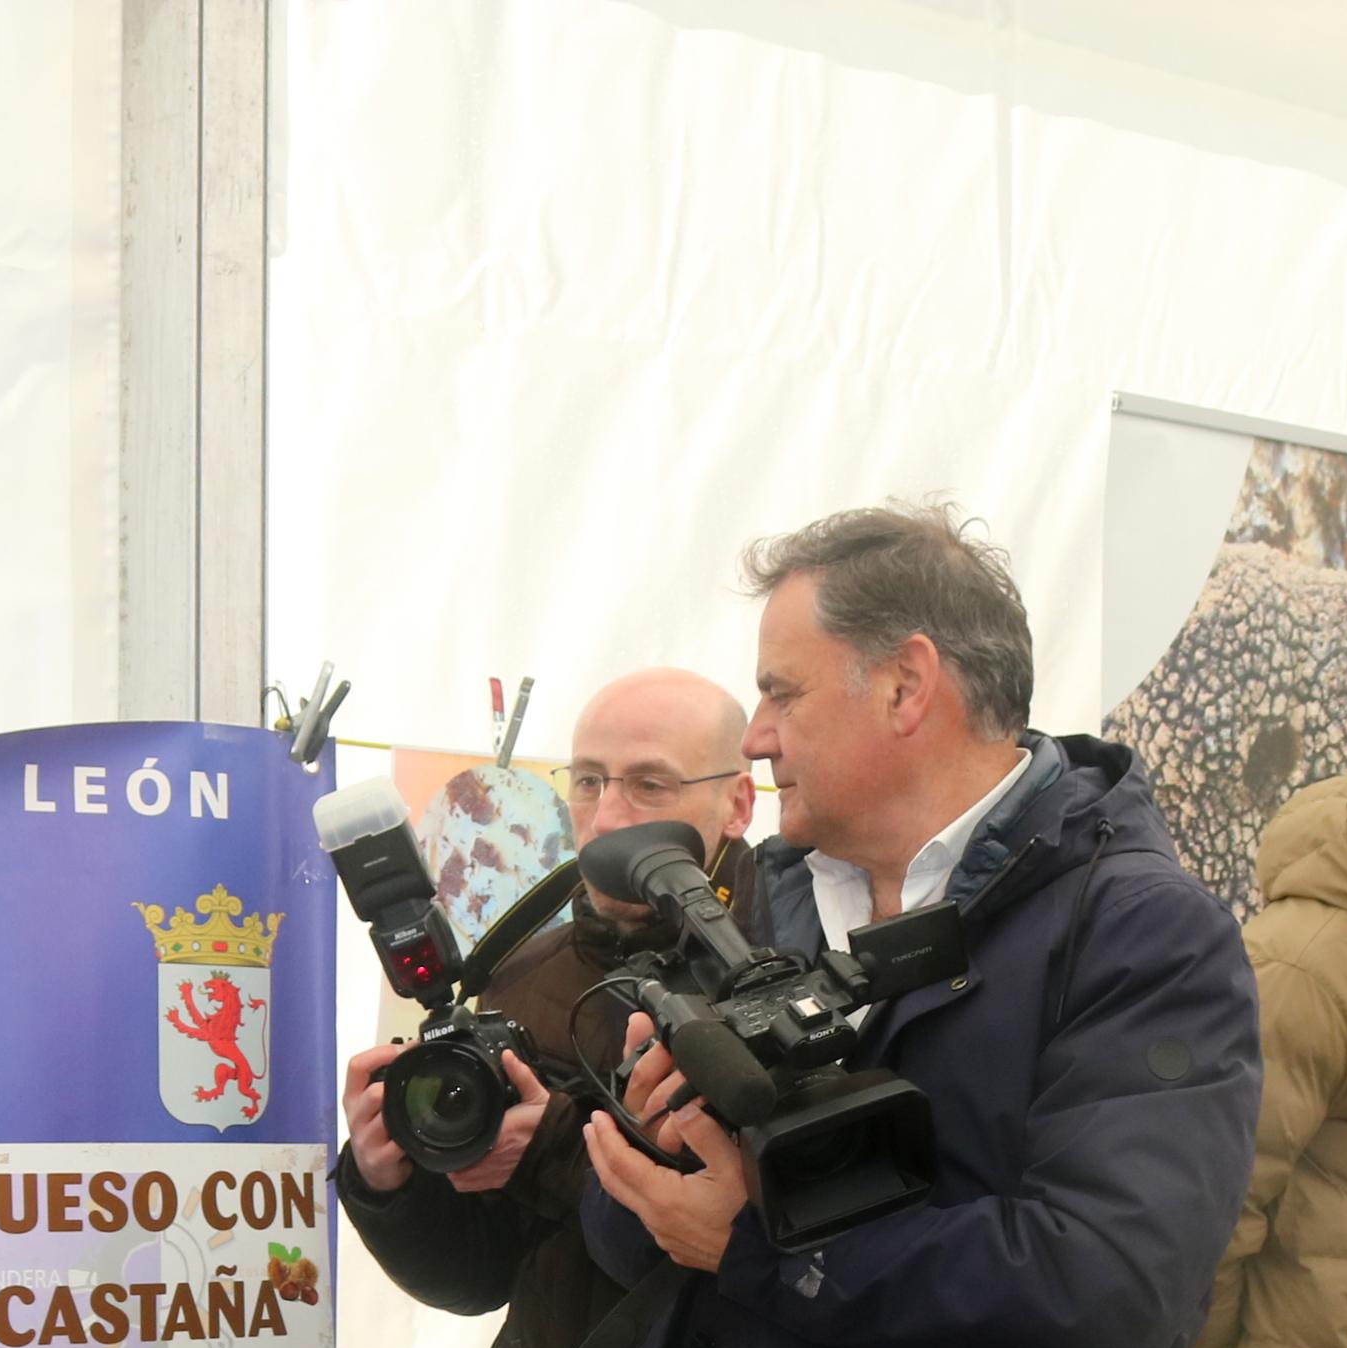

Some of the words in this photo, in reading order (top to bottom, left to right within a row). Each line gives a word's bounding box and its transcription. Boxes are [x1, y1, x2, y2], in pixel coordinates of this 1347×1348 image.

[23, 756, 231, 820] LEÓN
[423, 1024, 456, 1042] Nikon
[809, 1027, 837, 1042] SONY
[201, 1170, 316, 1231] CON
